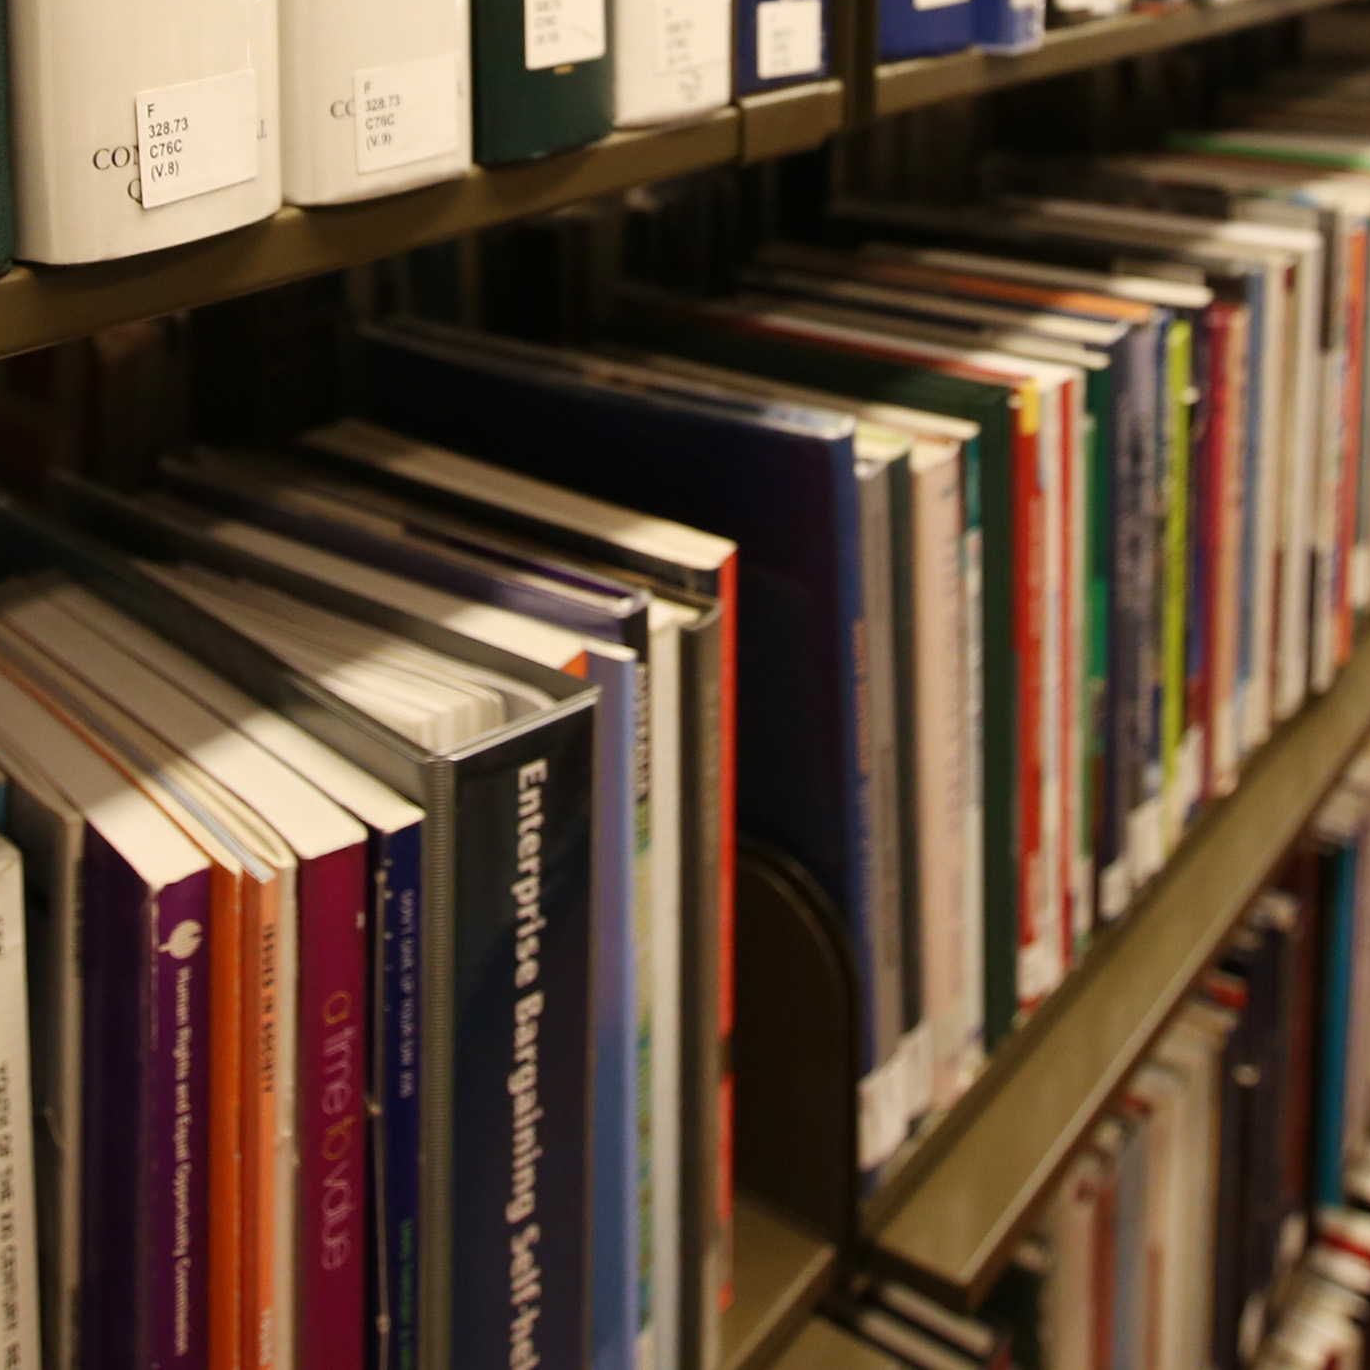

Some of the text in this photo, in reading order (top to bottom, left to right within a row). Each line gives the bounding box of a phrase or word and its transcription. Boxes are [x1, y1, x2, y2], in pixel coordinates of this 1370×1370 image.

[147, 102, 156, 118] F
[148, 116, 189, 139] 328.73
[149, 138, 183, 160] C76C
[150, 160, 180, 183] (V.8)
[511, 758, 548, 988] Enterprise
[506, 991, 544, 1224] Bargaining
